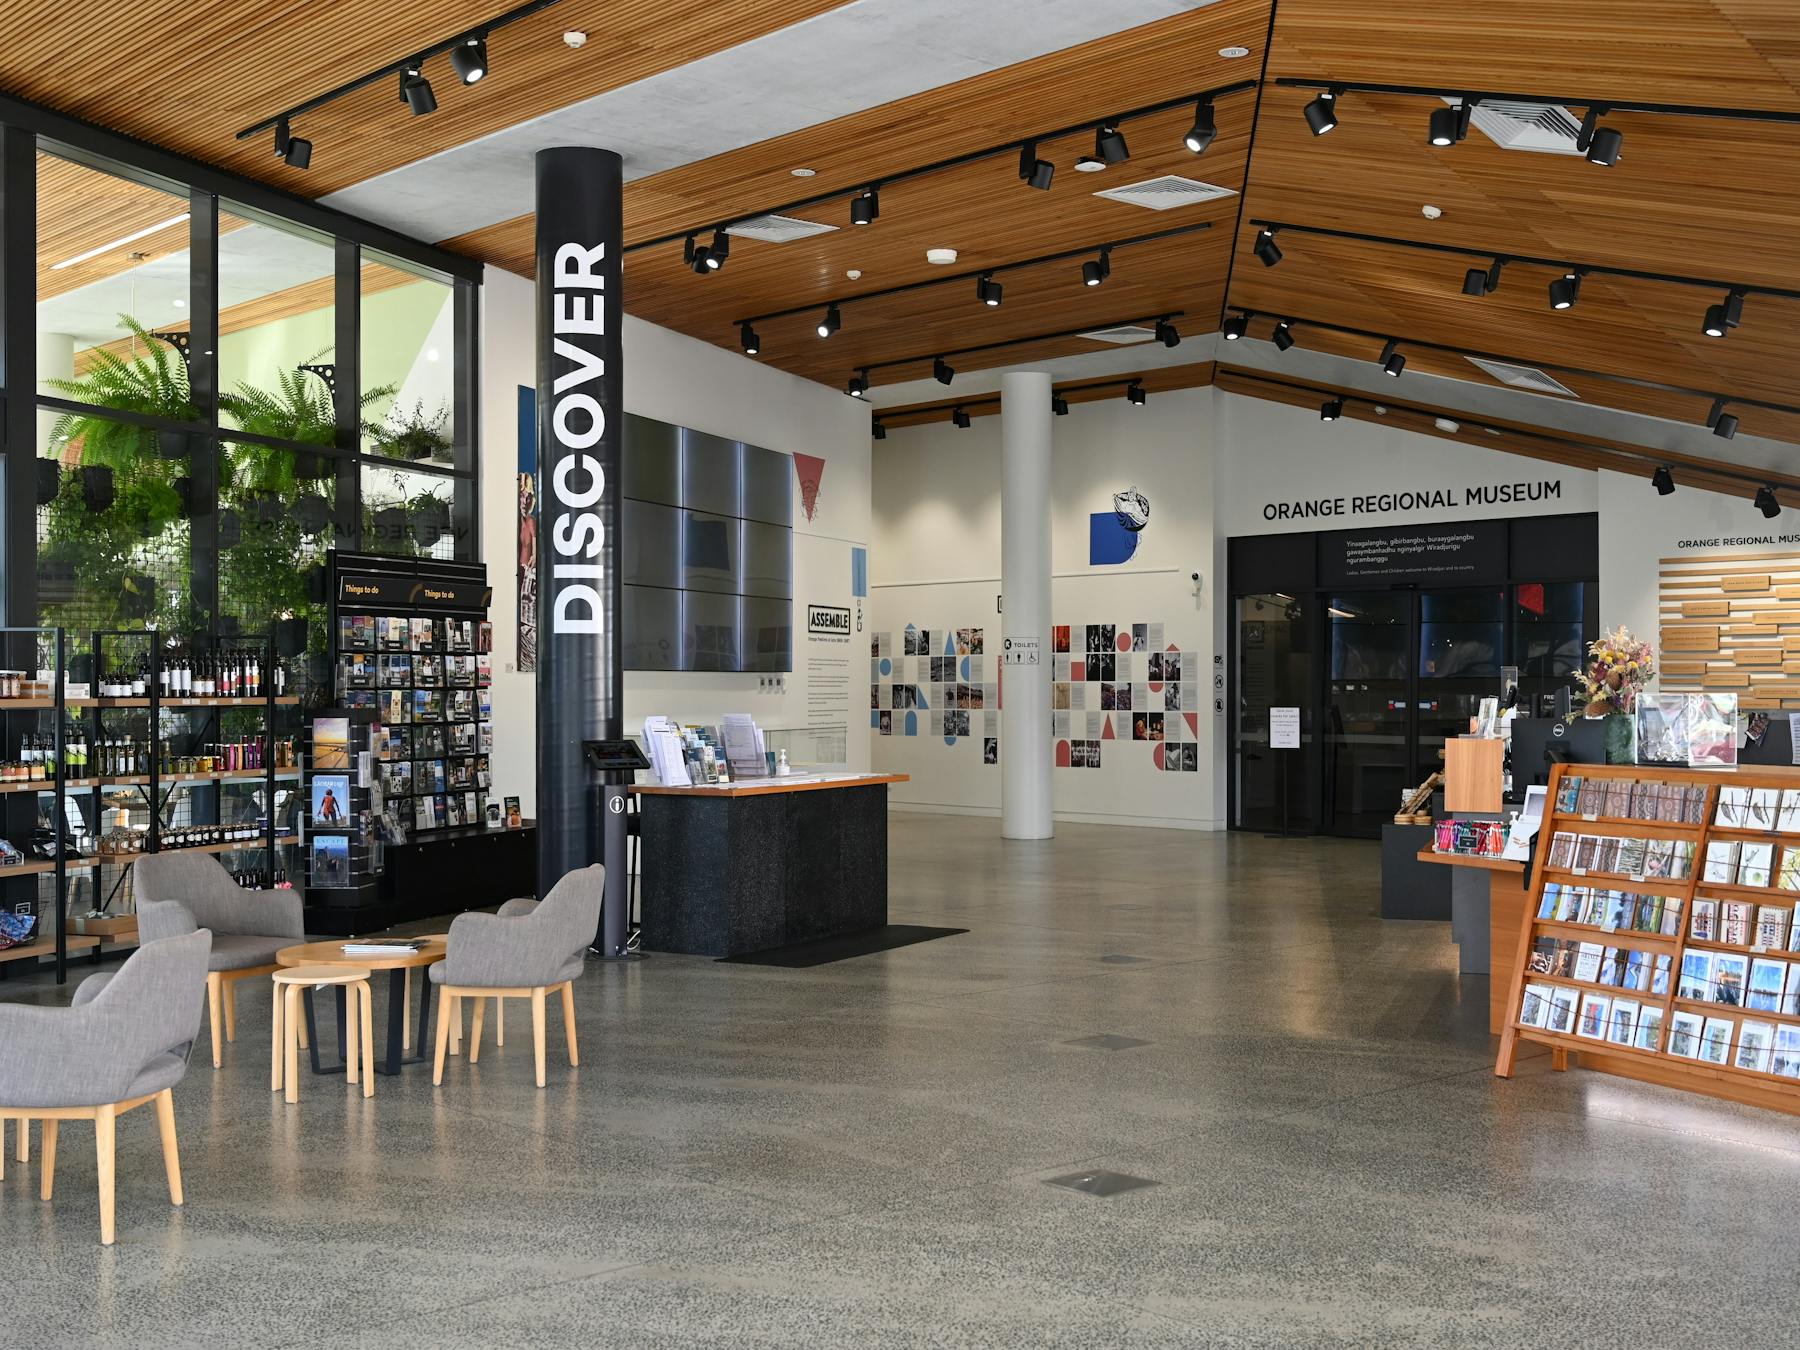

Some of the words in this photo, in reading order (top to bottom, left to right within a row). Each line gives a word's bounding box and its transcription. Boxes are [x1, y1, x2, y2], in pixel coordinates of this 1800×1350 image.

[553, 241, 605, 635] DISCOVER
[1263, 497, 1345, 521] ORANGE
[1352, 489, 1458, 515] REGIONAL
[1466, 480, 1562, 506] MUSEUM
[1677, 538, 1720, 549] ORANGE
[1723, 536, 1776, 546] REGIONAL
[345, 584, 363, 594] Things
[364, 585, 370, 593] to
[371, 585, 379, 594] do
[424, 589, 441, 600] Things
[441, 591, 447, 599] to
[448, 591, 455, 599] do
[811, 611, 848, 629] ASSEMBLE
